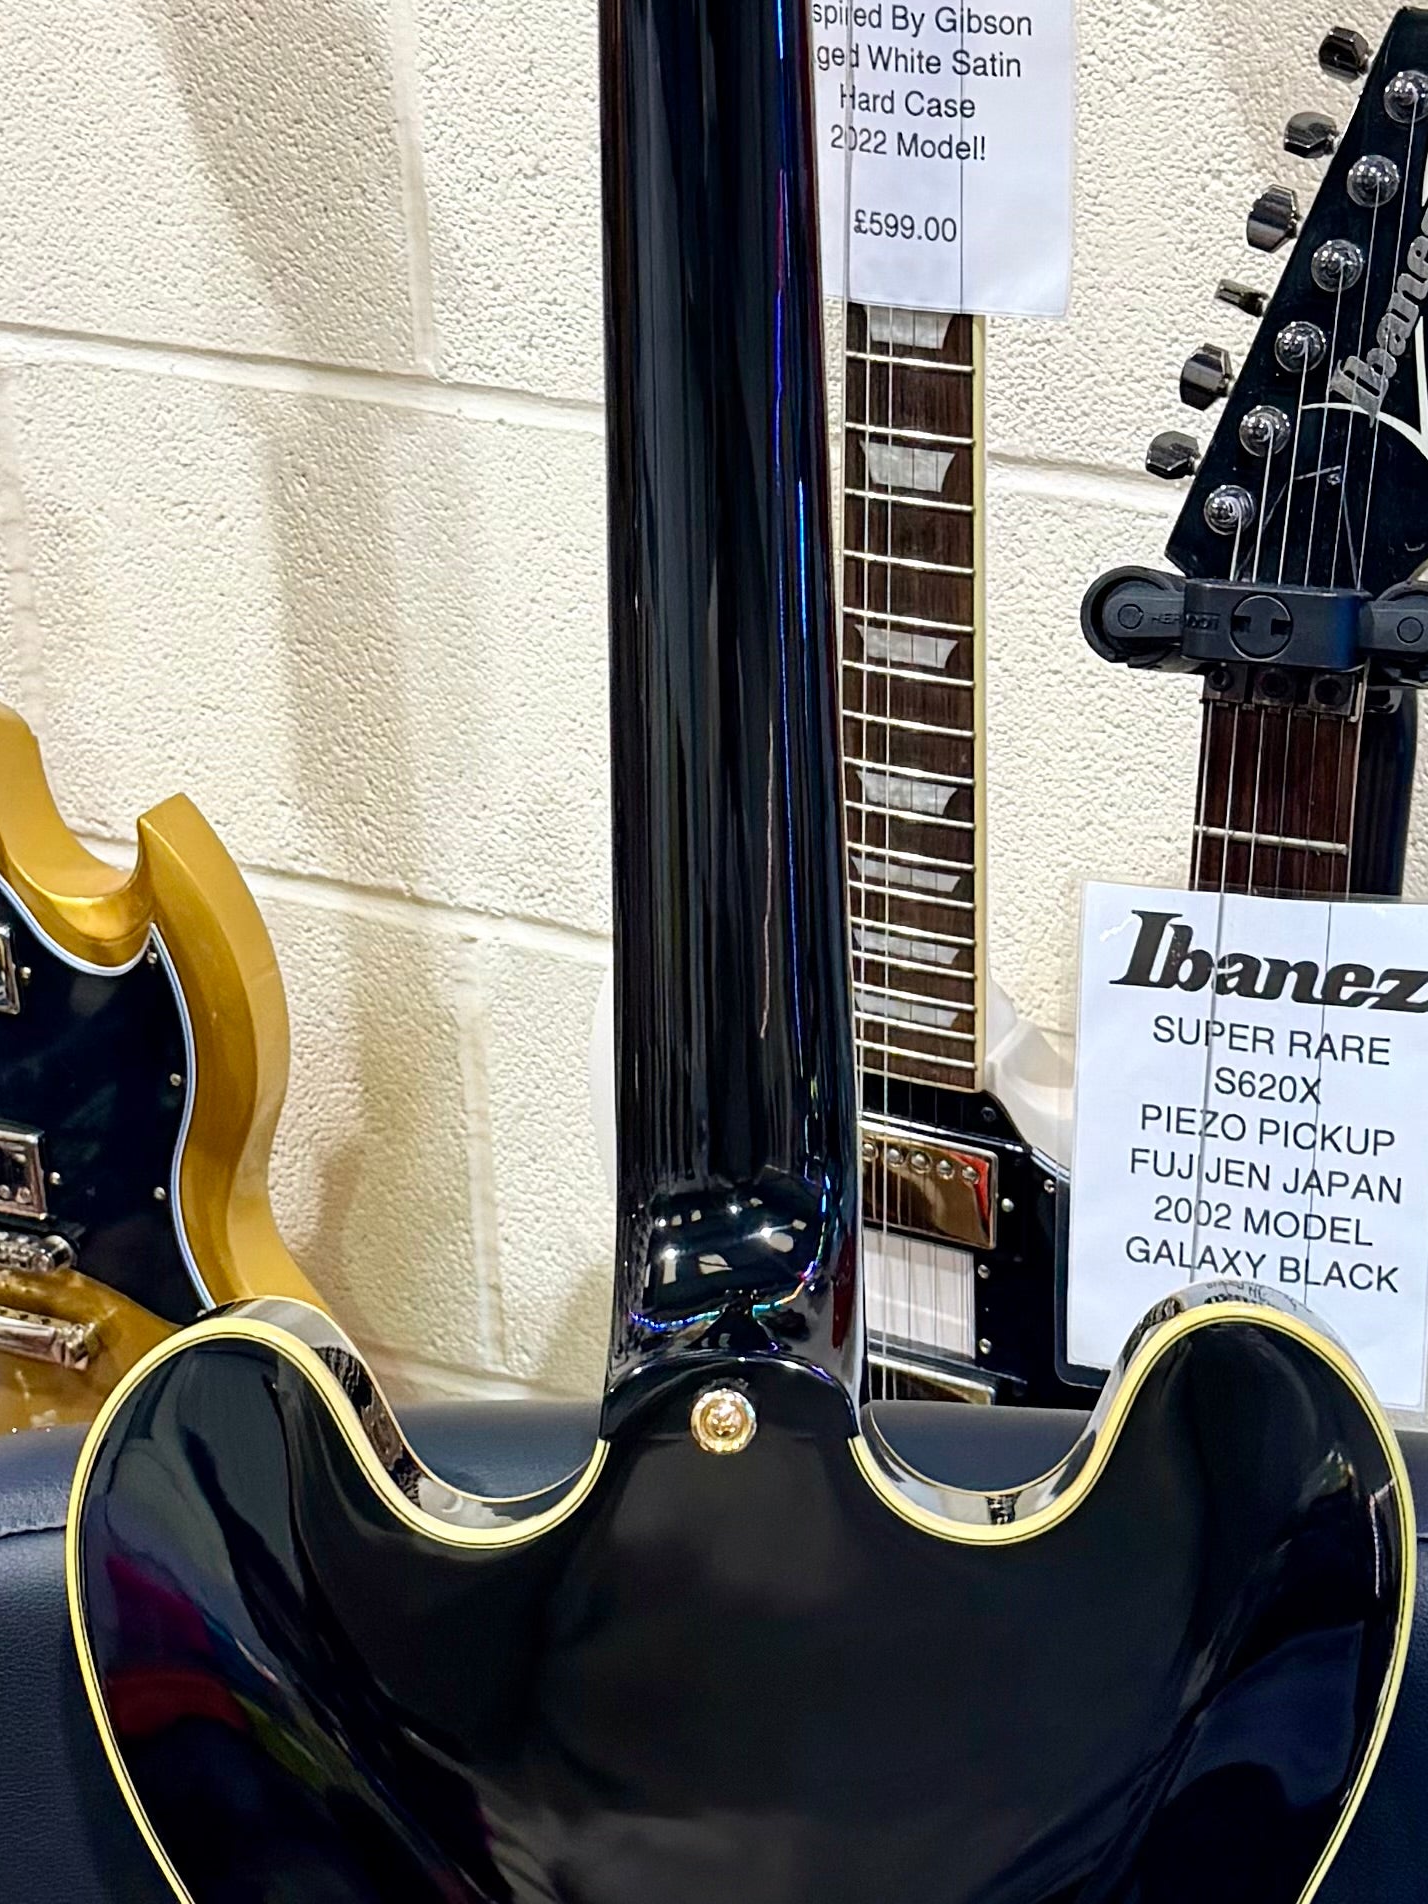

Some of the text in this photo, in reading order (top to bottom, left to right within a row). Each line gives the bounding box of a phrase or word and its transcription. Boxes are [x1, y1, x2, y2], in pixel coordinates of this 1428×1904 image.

[812, 0, 1033, 39] spired By Gibson
[816, 43, 1021, 79] ged White Satin
[839, 83, 976, 120] Hard Case
[830, 124, 987, 161] 2022 Model!
[853, 210, 957, 243] £599.00
[1153, 1014, 1392, 1066] SUPER RARE
[1213, 1066, 1323, 1106] S620X
[1140, 1103, 1397, 1158] PIEZO PICKUP
[1282, 1166, 1402, 1205] JAPAN
[1154, 1194, 1374, 1247] 2002 MODEL
[1125, 1235, 1267, 1280] GALAXY
[1278, 1255, 1400, 1294] BLACK
